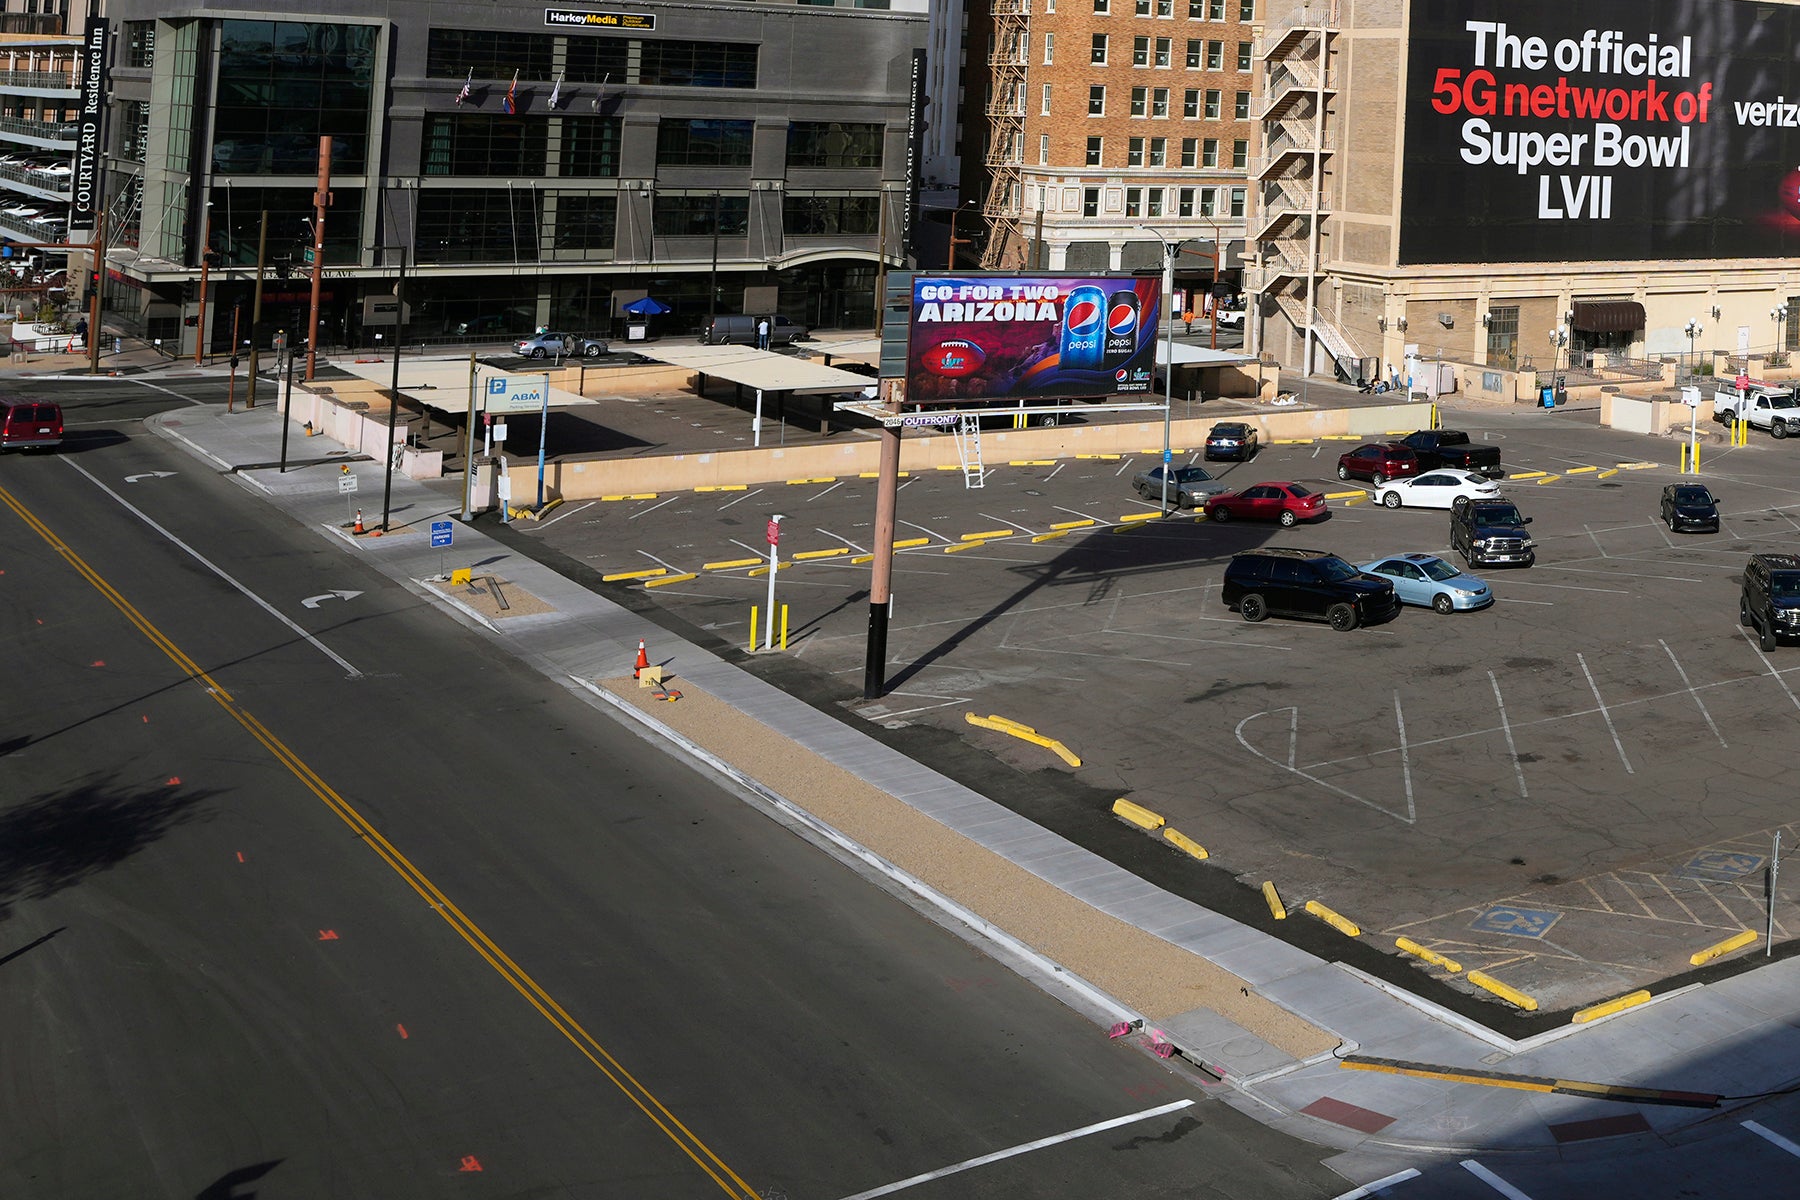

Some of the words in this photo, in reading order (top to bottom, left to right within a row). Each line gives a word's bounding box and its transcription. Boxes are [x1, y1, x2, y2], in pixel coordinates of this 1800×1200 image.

[551, 12, 617, 24] HarkeyMedia
[94, 27, 104, 50] Inn
[1466, 20, 1548, 71] The
[1554, 29, 1692, 77] official
[84, 52, 101, 114] Residence
[1431, 68, 1497, 116] 5G
[1503, 76, 1669, 122] network
[1673, 82, 1713, 123] of
[903, 146, 913, 232] COURTYARD
[908, 75, 918, 139] Residence
[1459, 117, 1588, 175] Super
[1593, 122, 1690, 167] Bowl
[76, 122, 96, 212] COURTYARD
[1538, 175, 1612, 219] LVII
[921, 285, 947, 300] GO
[960, 285, 1003, 300] FOR
[1010, 285, 1059, 300] TWO
[918, 302, 1059, 322] ARIZONA
[1068, 340, 1096, 351] pepsi
[1108, 338, 1131, 348] pepsi
[493, 381, 503, 393] P
[511, 392, 540, 401] ABM
[884, 418, 901, 426] 2046
[905, 415, 956, 426] OUTFRONT
